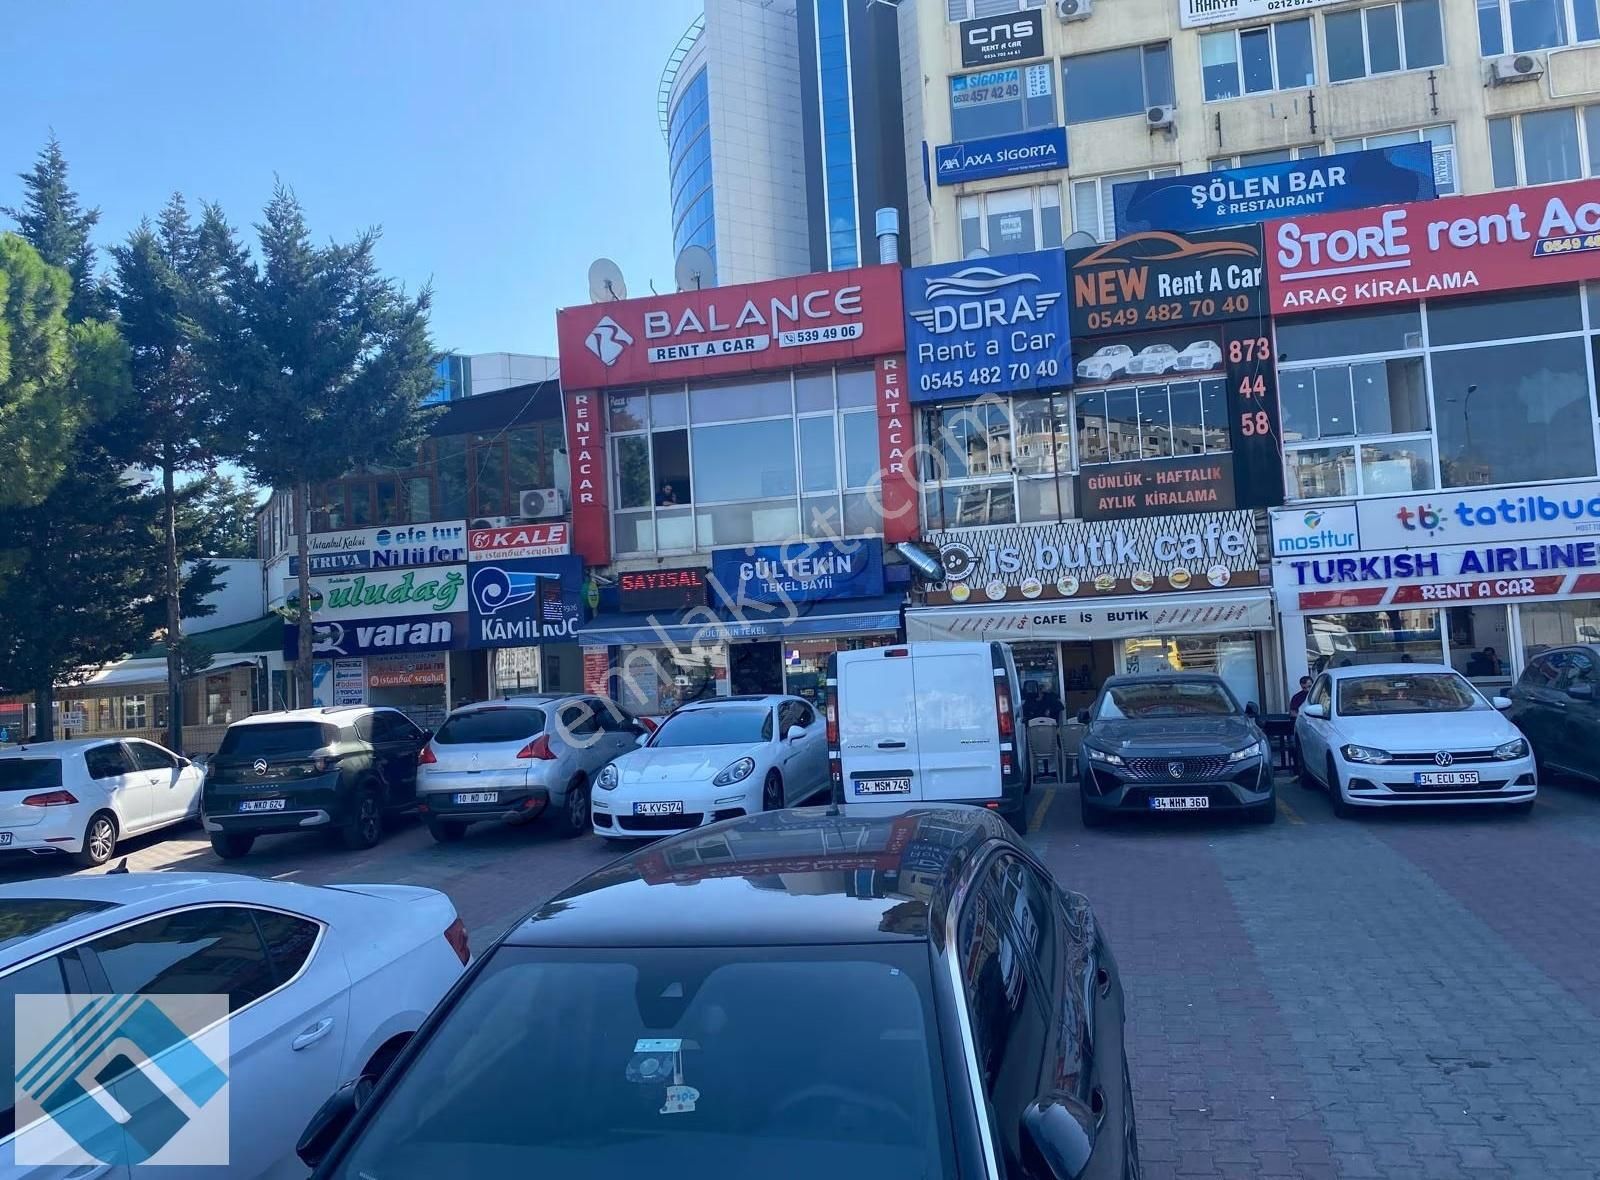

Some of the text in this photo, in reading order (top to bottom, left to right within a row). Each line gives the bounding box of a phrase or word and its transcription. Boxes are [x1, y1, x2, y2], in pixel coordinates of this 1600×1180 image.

[1268, 1, 1293, 10] 0212
[981, 44, 999, 52] RENT
[971, 89, 990, 102] 457
[991, 86, 1005, 99] 42
[1006, 83, 1019, 97] 49
[965, 154, 993, 167] AXA
[1191, 166, 1347, 209] ŞÖLEN BAR
[1216, 191, 1326, 216] & RESTAURANT
[1277, 209, 1412, 269] STORE
[1427, 203, 1531, 251] rent
[1543, 237, 1581, 253] 0549
[1074, 264, 1262, 308] NEW Rent A Car
[1283, 270, 1480, 308] ARAÇ KİRALAMA
[644, 285, 863, 340] BALANCE
[934, 294, 1036, 334] DORA
[1088, 295, 1249, 330] 0549 482 70 40
[797, 325, 857, 343] 539 49 06
[656, 338, 756, 361] RENT A CAR
[919, 331, 1056, 363] Rent a Car
[1229, 337, 1270, 363] 873
[920, 359, 1058, 391] 0545 482 70 40
[1239, 374, 1266, 398] 44
[1241, 411, 1270, 436] 58
[1088, 472, 1143, 490] GÜNLÜK
[1156, 467, 1221, 486] HAFTALIK
[1099, 488, 1217, 510] AYLIK KİRALAMA
[396, 526, 462, 545] efe tur
[492, 525, 564, 546] KALE
[1034, 527, 1140, 571] butik
[1154, 522, 1245, 562] cafe
[1279, 530, 1354, 551] mosttur
[311, 555, 361, 568] TRUVA
[371, 545, 463, 567] Nilüfer
[739, 552, 851, 581] GÜLTEKİN
[1291, 542, 1600, 585] TURKISH AIRLINE
[328, 571, 464, 611] uludağ
[761, 583, 797, 593] TEKEL
[1421, 578, 1536, 600] RENT A CAR
[481, 616, 540, 641] KÂMİL
[1033, 611, 1149, 625] CAFE İS BUTİK
[356, 620, 451, 648] varan
[860, 780, 908, 792] 34 MSM 749
[1422, 773, 1477, 784] 34 ECU 955
[1156, 798, 1166, 808] 34
[1190, 798, 1207, 807] 360
